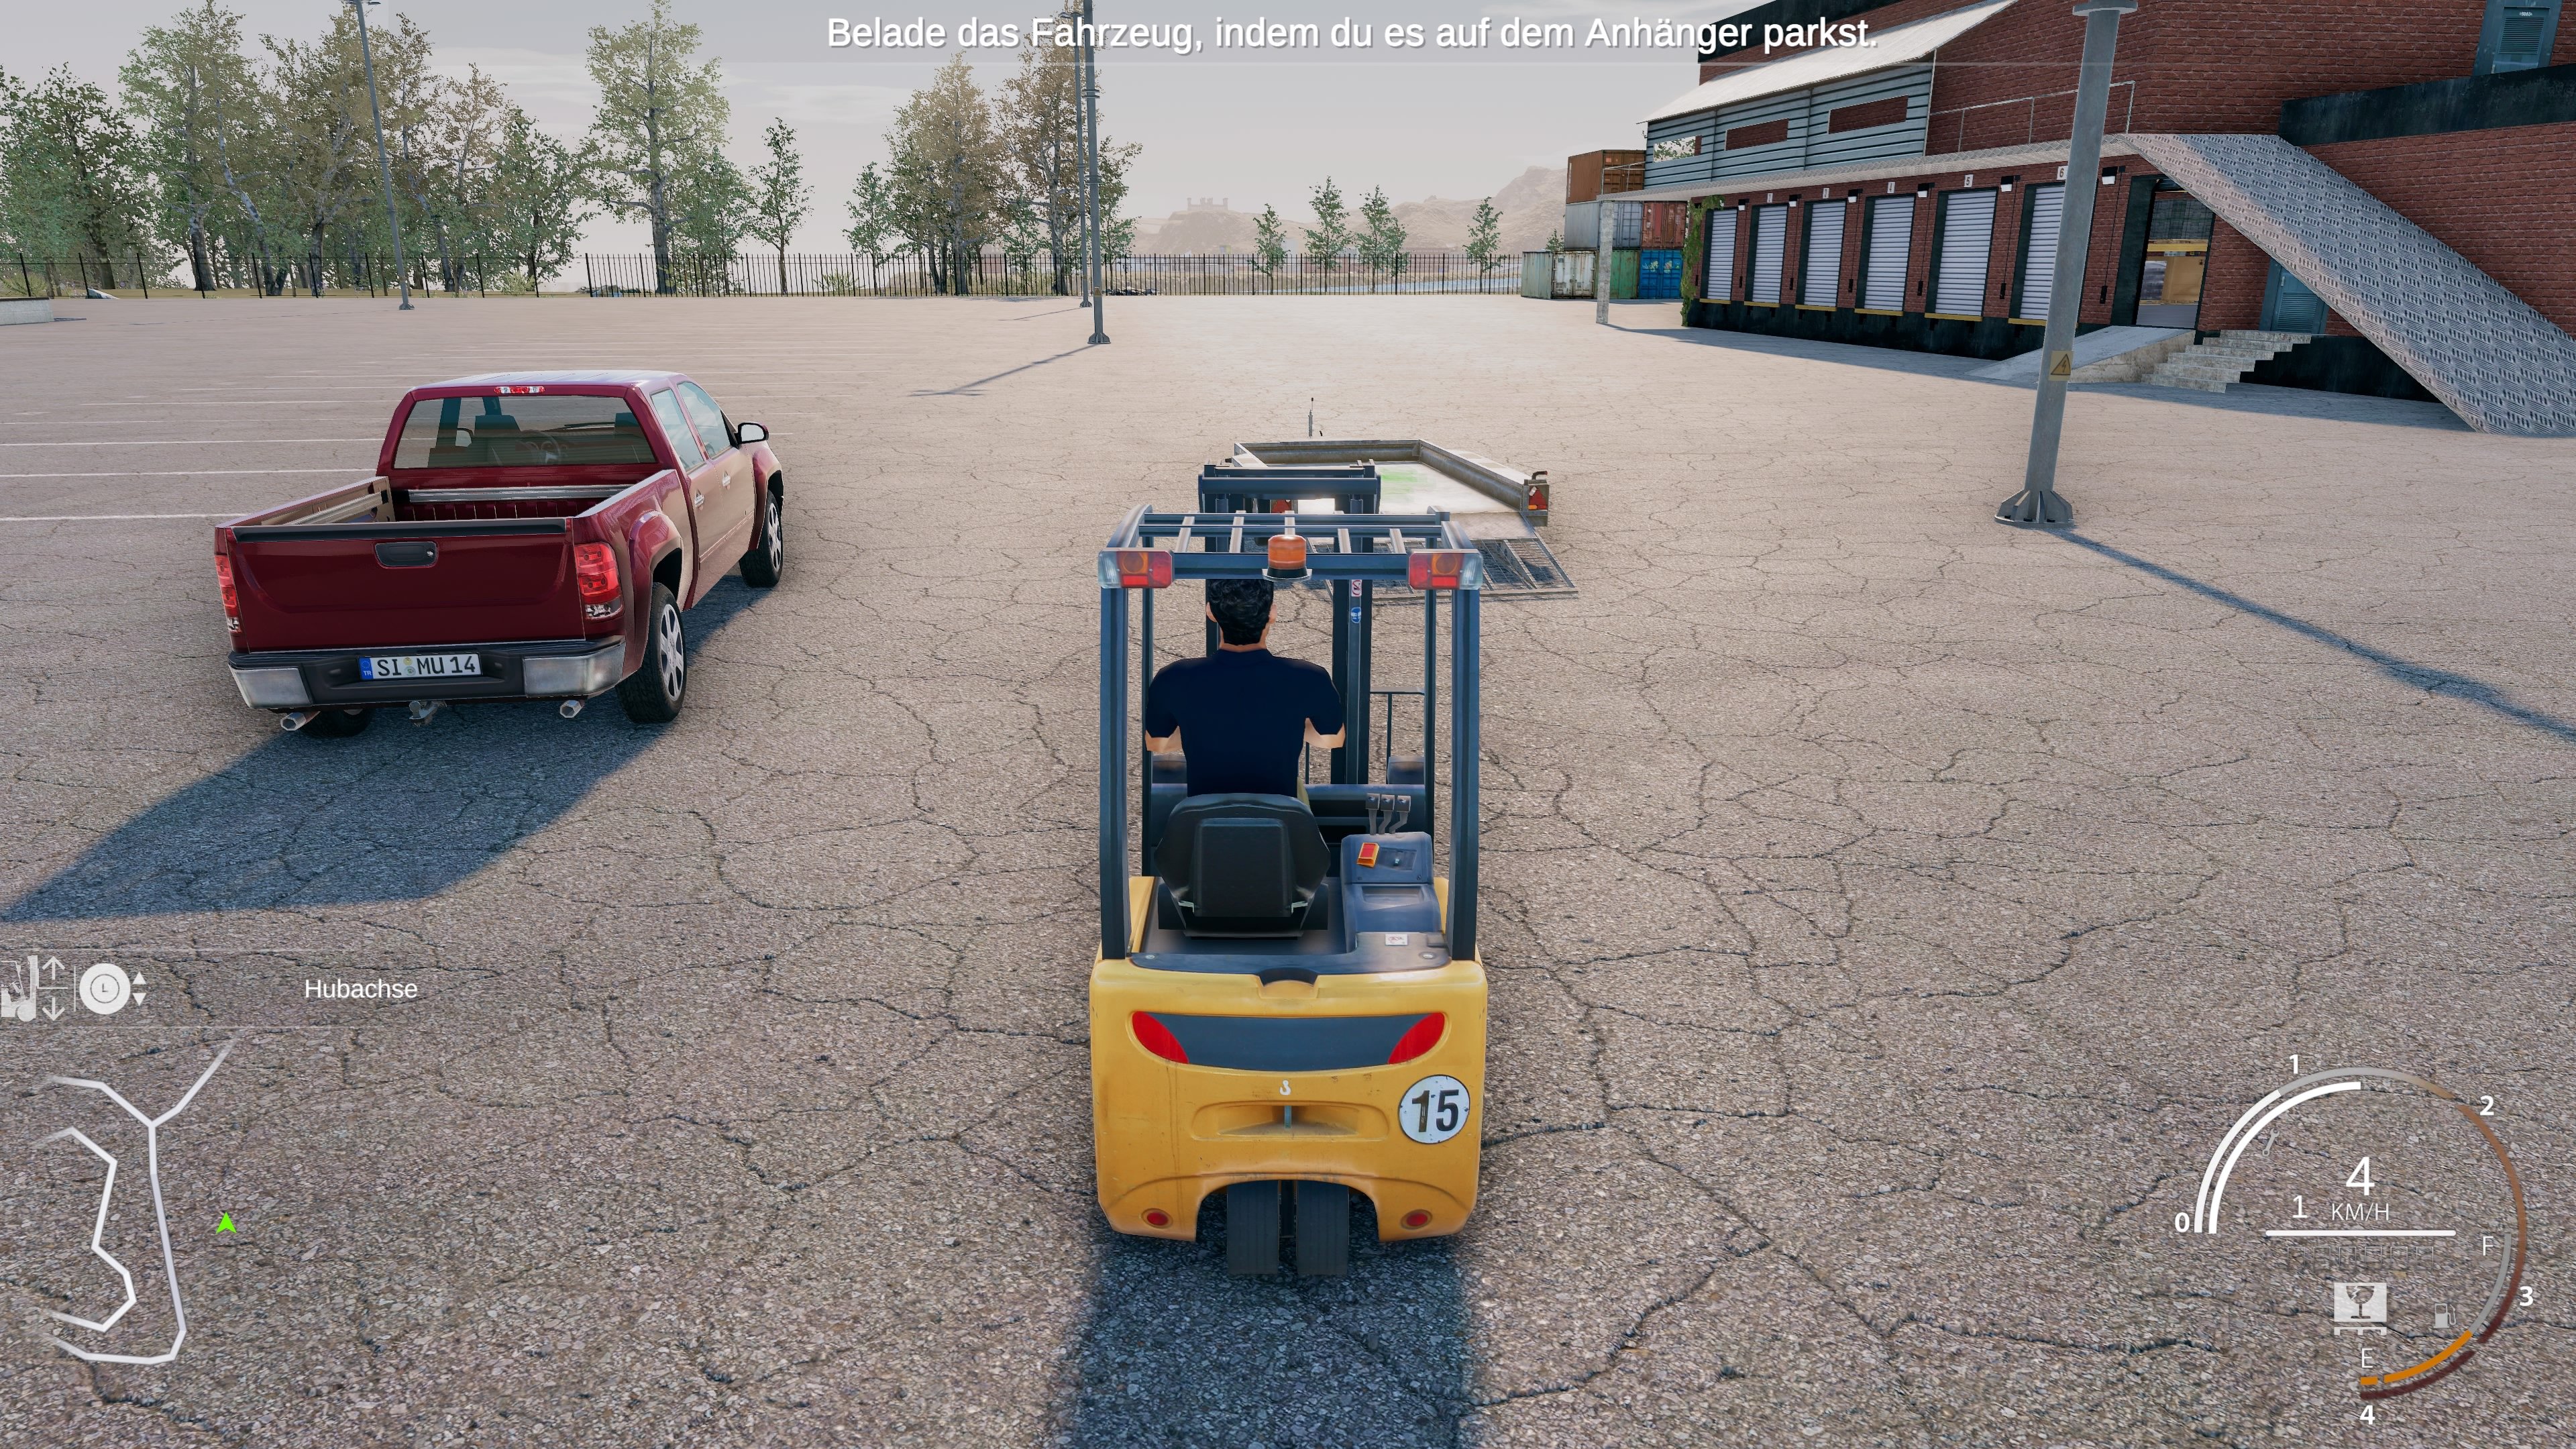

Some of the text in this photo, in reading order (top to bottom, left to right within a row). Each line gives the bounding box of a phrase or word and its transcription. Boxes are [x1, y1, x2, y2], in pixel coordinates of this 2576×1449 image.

[2059, 168, 2064, 178] 6
[1966, 176, 1970, 186] 5
[377, 655, 476, 676] SI MU 14
[1412, 1089, 1459, 1133] 15
